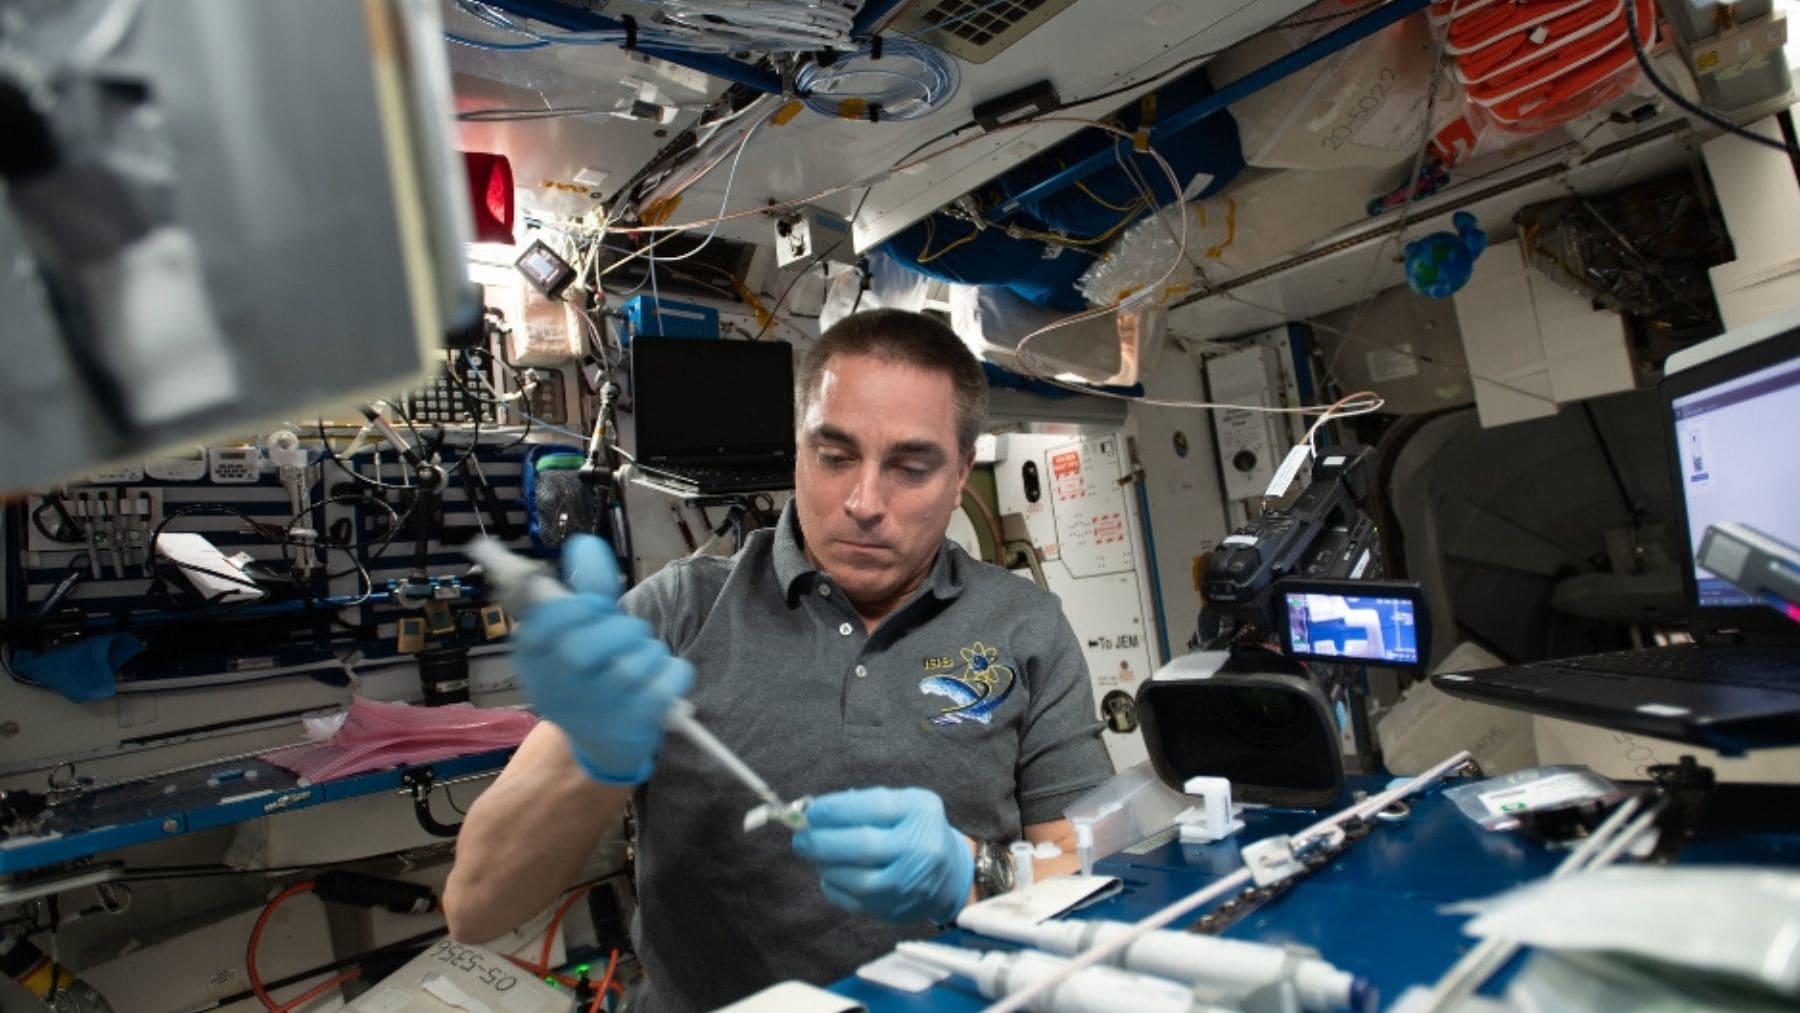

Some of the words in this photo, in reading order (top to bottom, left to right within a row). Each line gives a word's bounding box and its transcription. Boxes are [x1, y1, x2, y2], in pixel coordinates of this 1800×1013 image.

[1098, 636, 1113, 650] To
[1114, 634, 1140, 649] JEM
[430, 939, 518, 991] 05-5356
